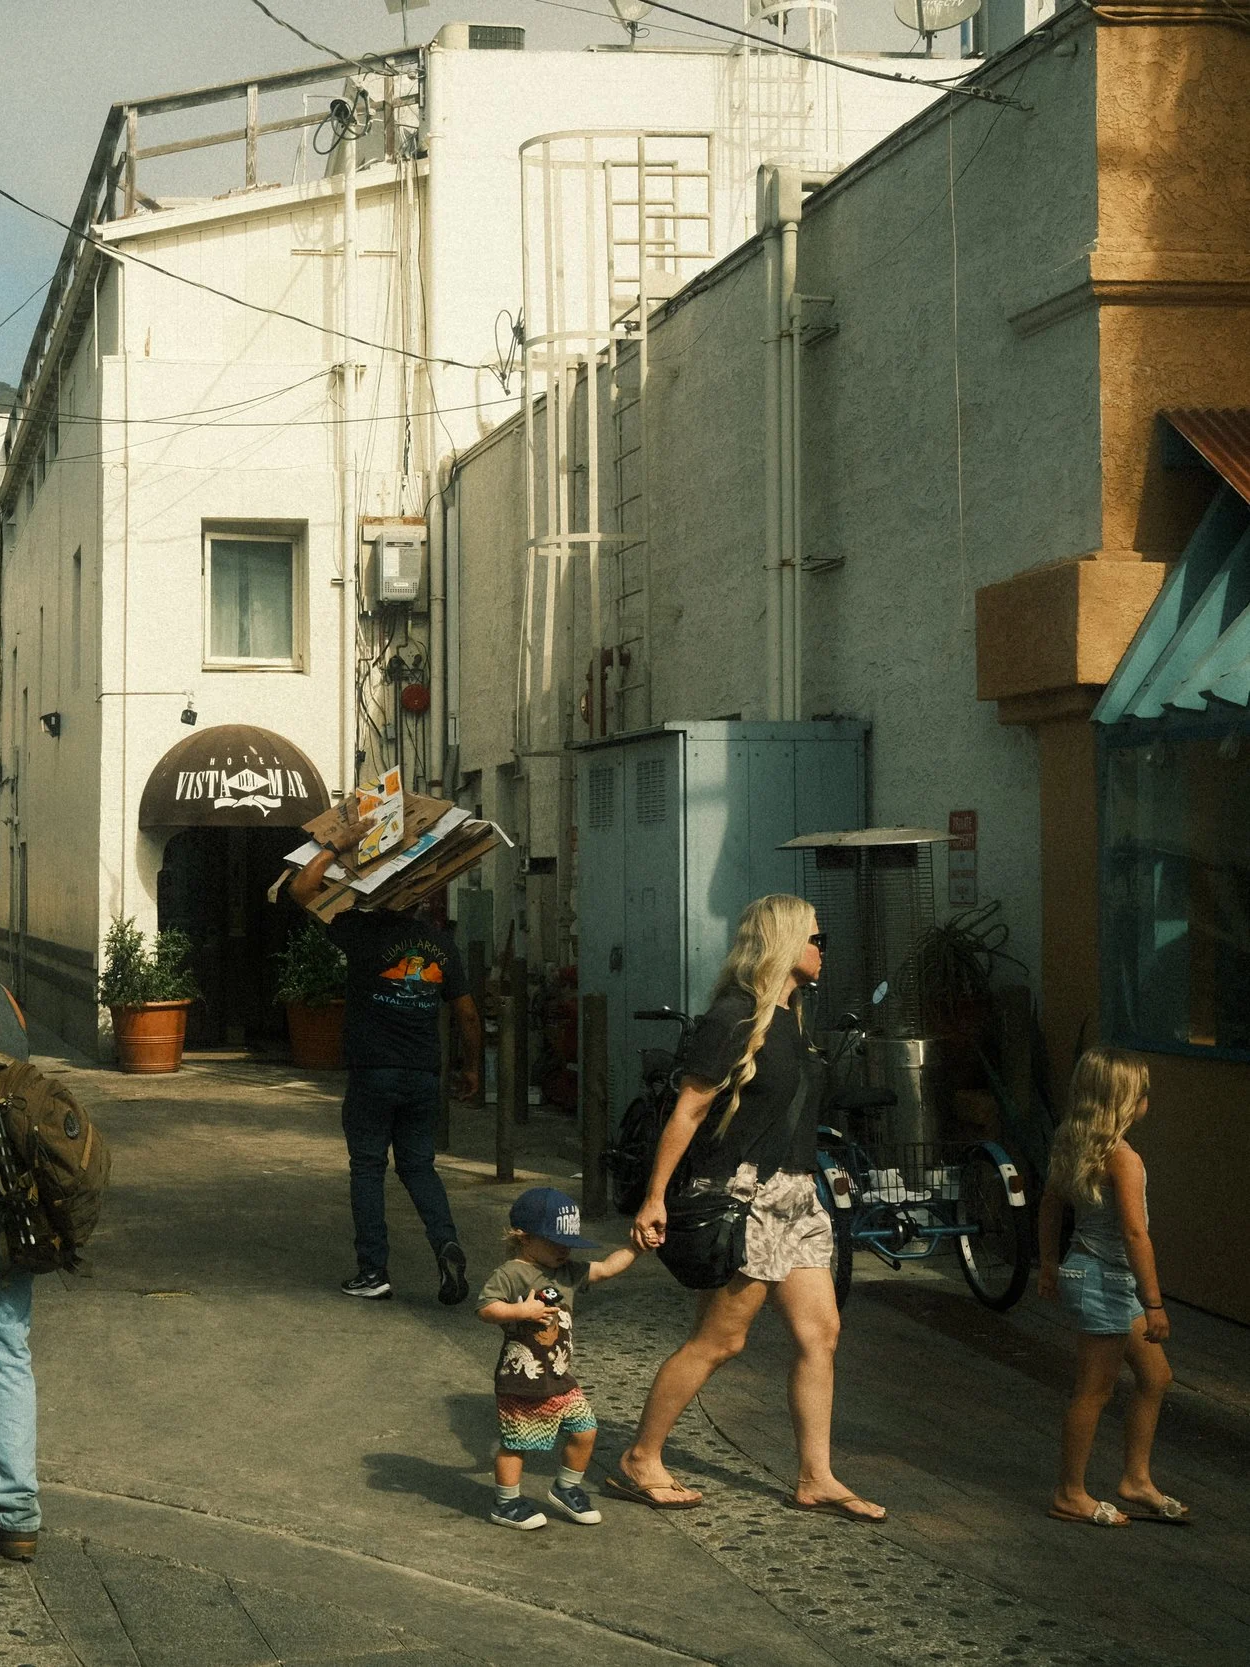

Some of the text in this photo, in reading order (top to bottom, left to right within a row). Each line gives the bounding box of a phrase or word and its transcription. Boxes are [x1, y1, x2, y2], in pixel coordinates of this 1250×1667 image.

[209, 755, 280, 766] HOTEL
[175, 768, 309, 801] VISTA DEL MAR
